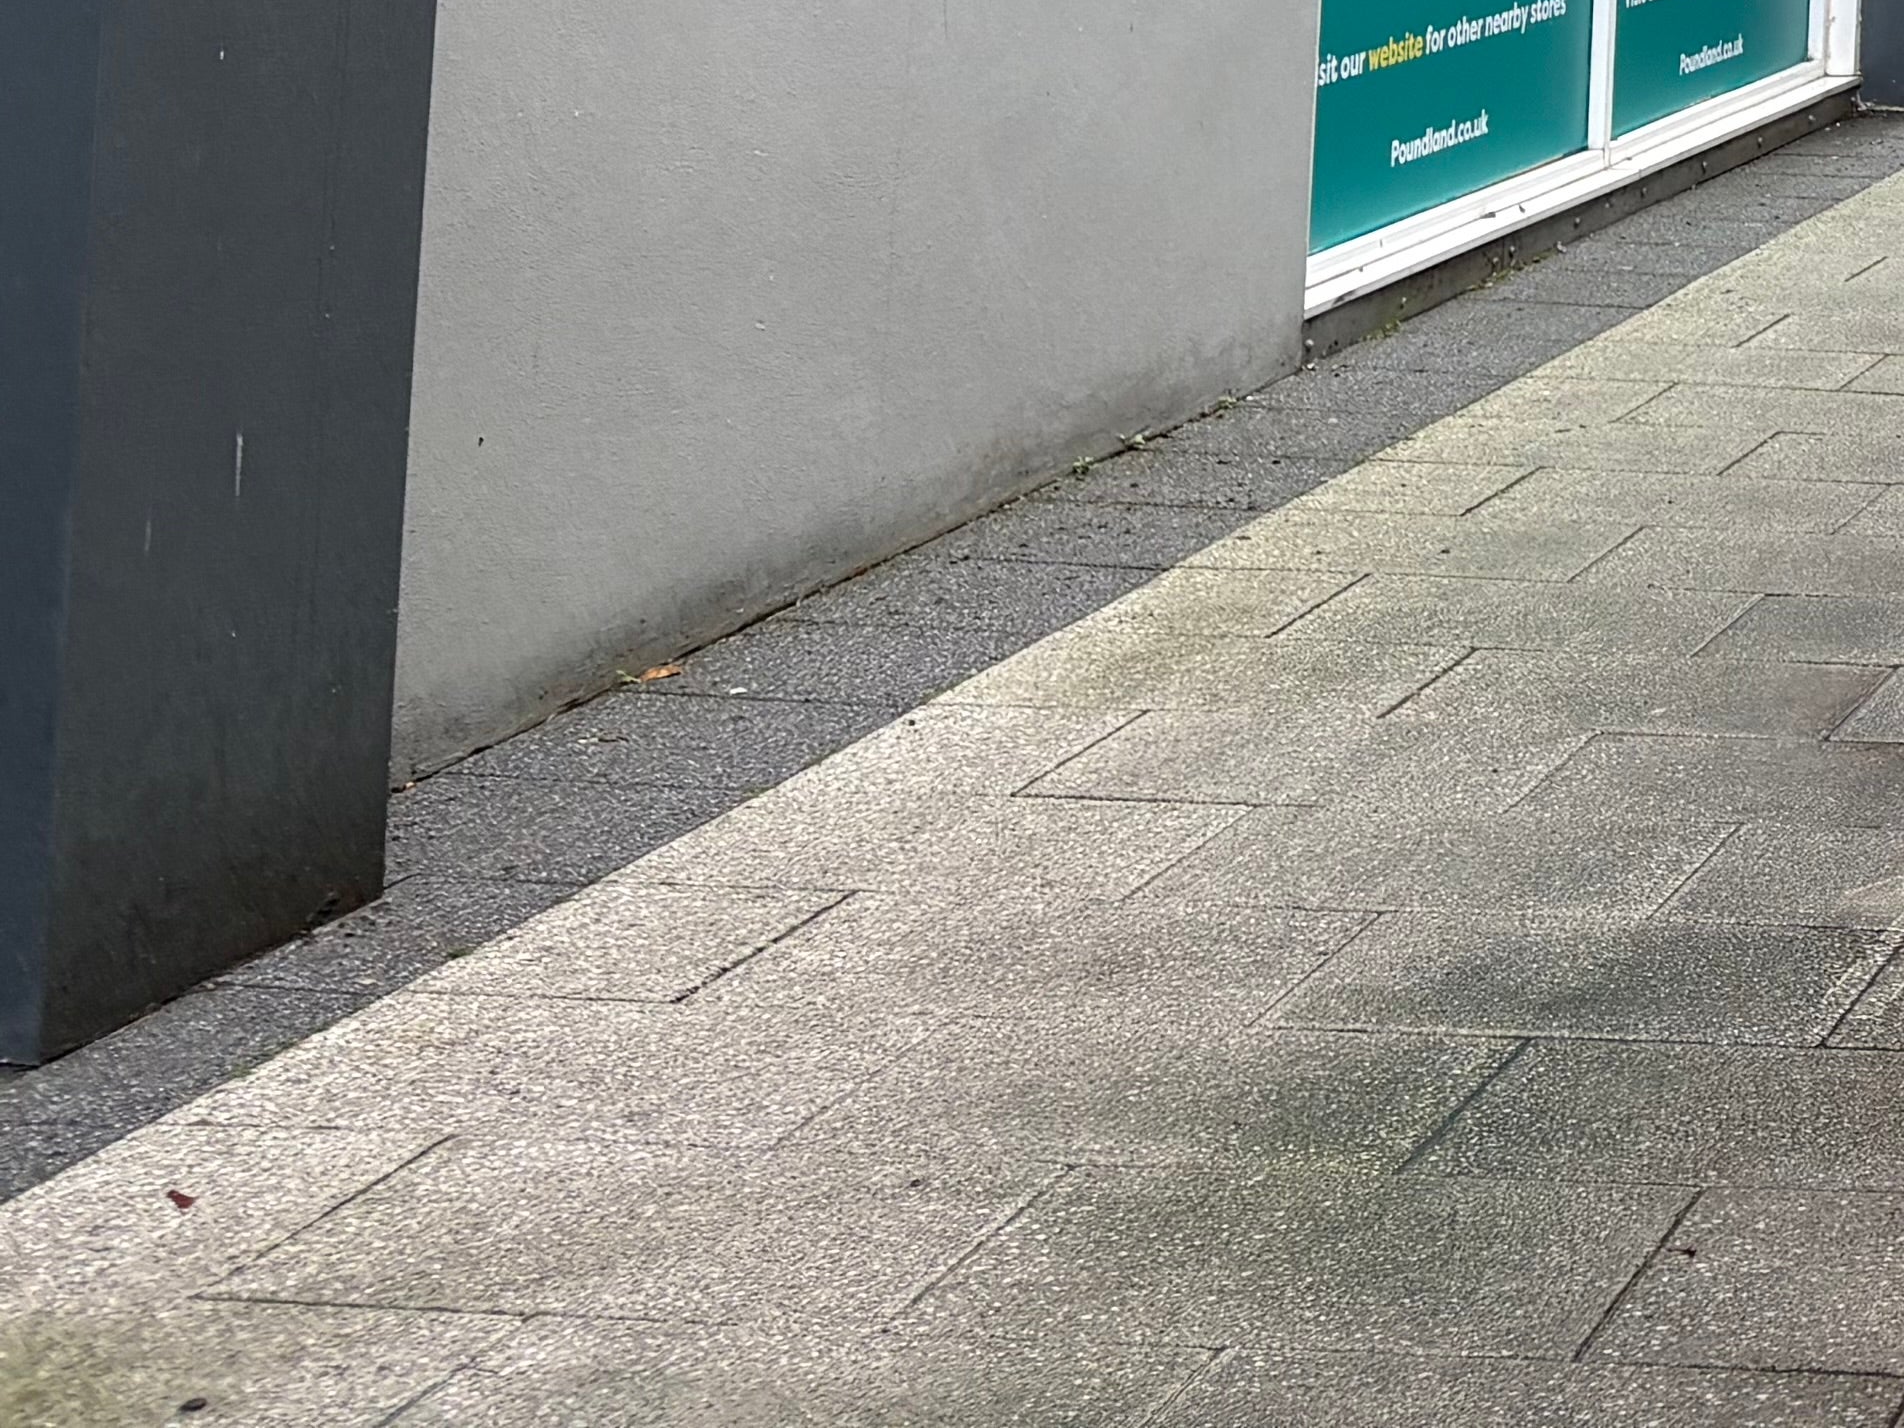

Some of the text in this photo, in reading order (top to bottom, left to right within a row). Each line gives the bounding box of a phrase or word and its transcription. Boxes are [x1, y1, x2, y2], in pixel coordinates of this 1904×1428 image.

[1318, 54, 1338, 86] sit
[1340, 51, 1367, 79] our
[1368, 32, 1424, 71] website
[1425, 25, 1446, 55] for
[1447, 16, 1484, 48] other
[1484, 2, 1529, 37] nearby
[1679, 35, 1744, 75] Poundland.co.uk
[1391, 109, 1489, 167] Poundland.co.uk
